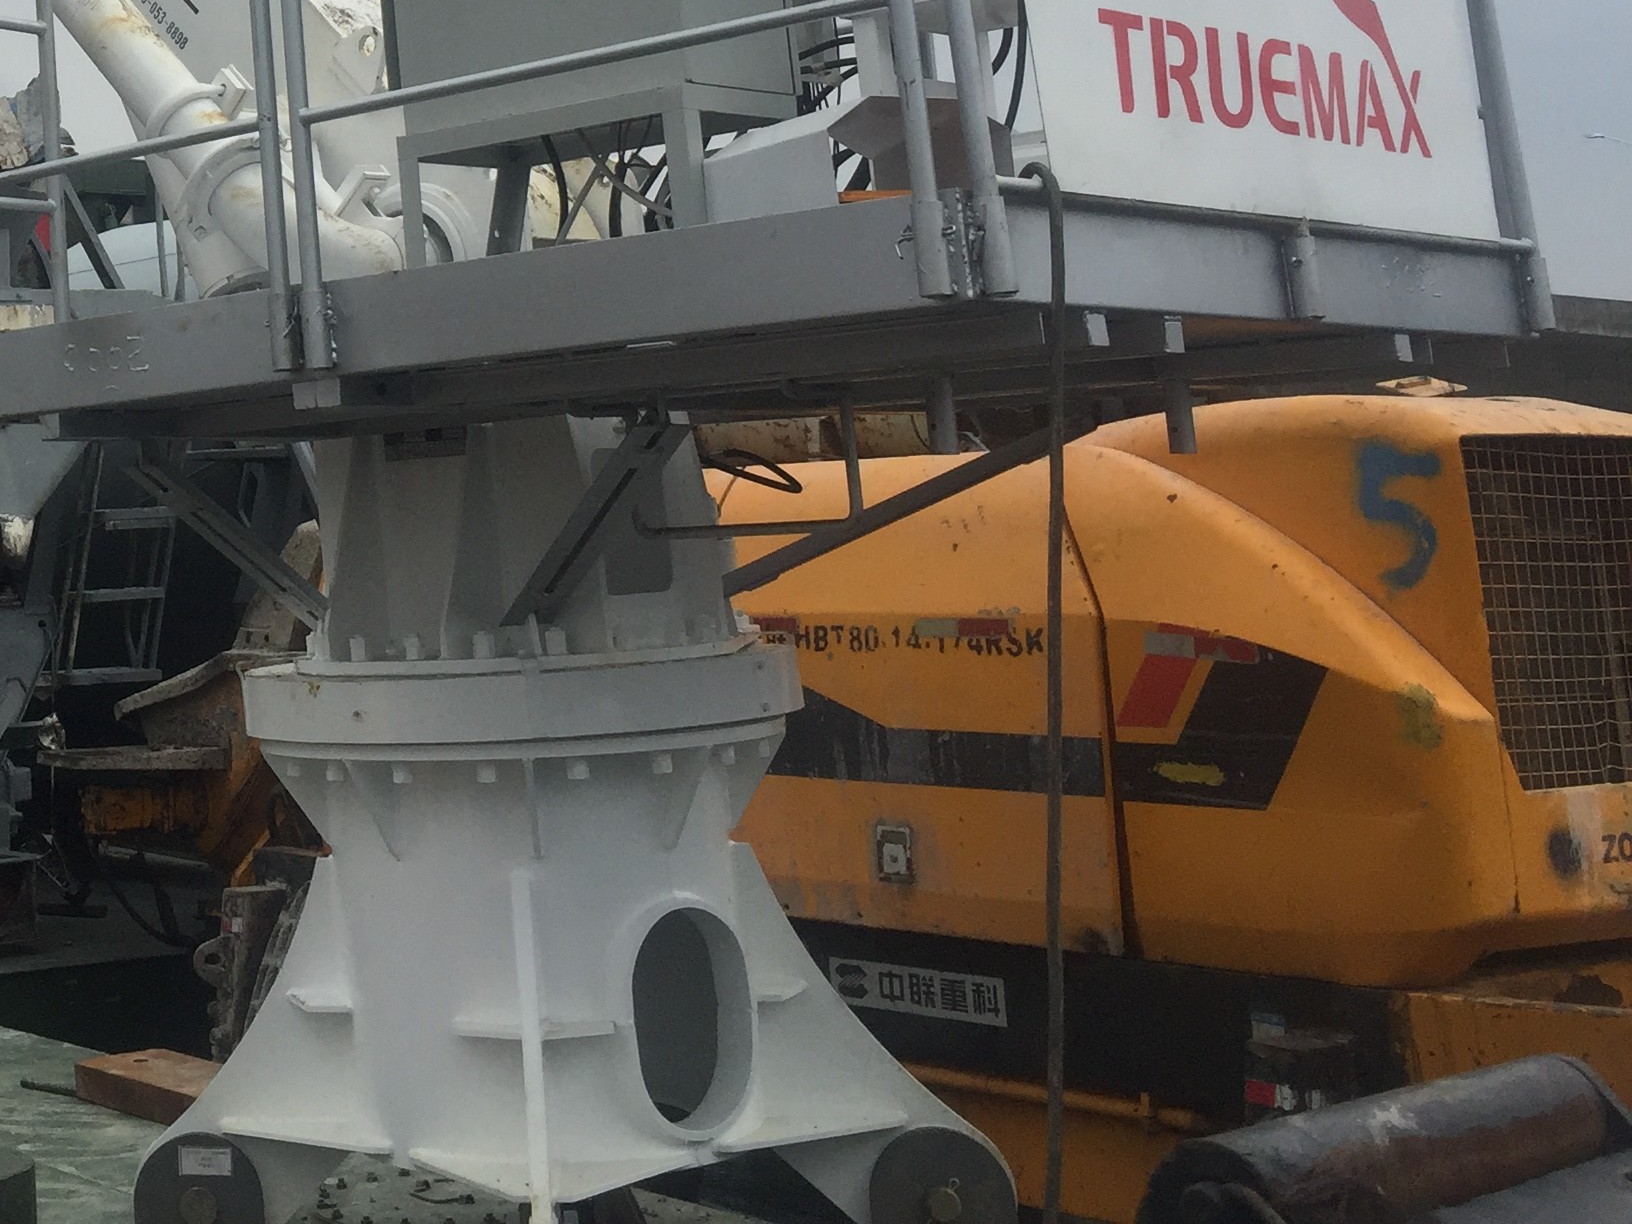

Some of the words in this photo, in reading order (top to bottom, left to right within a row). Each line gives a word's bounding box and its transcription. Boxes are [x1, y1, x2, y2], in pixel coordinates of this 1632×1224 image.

[1098, 7, 1432, 158] TRUEMAX
[1355, 436, 1441, 590] 5
[879, 969, 1000, 1018] 中联重科
